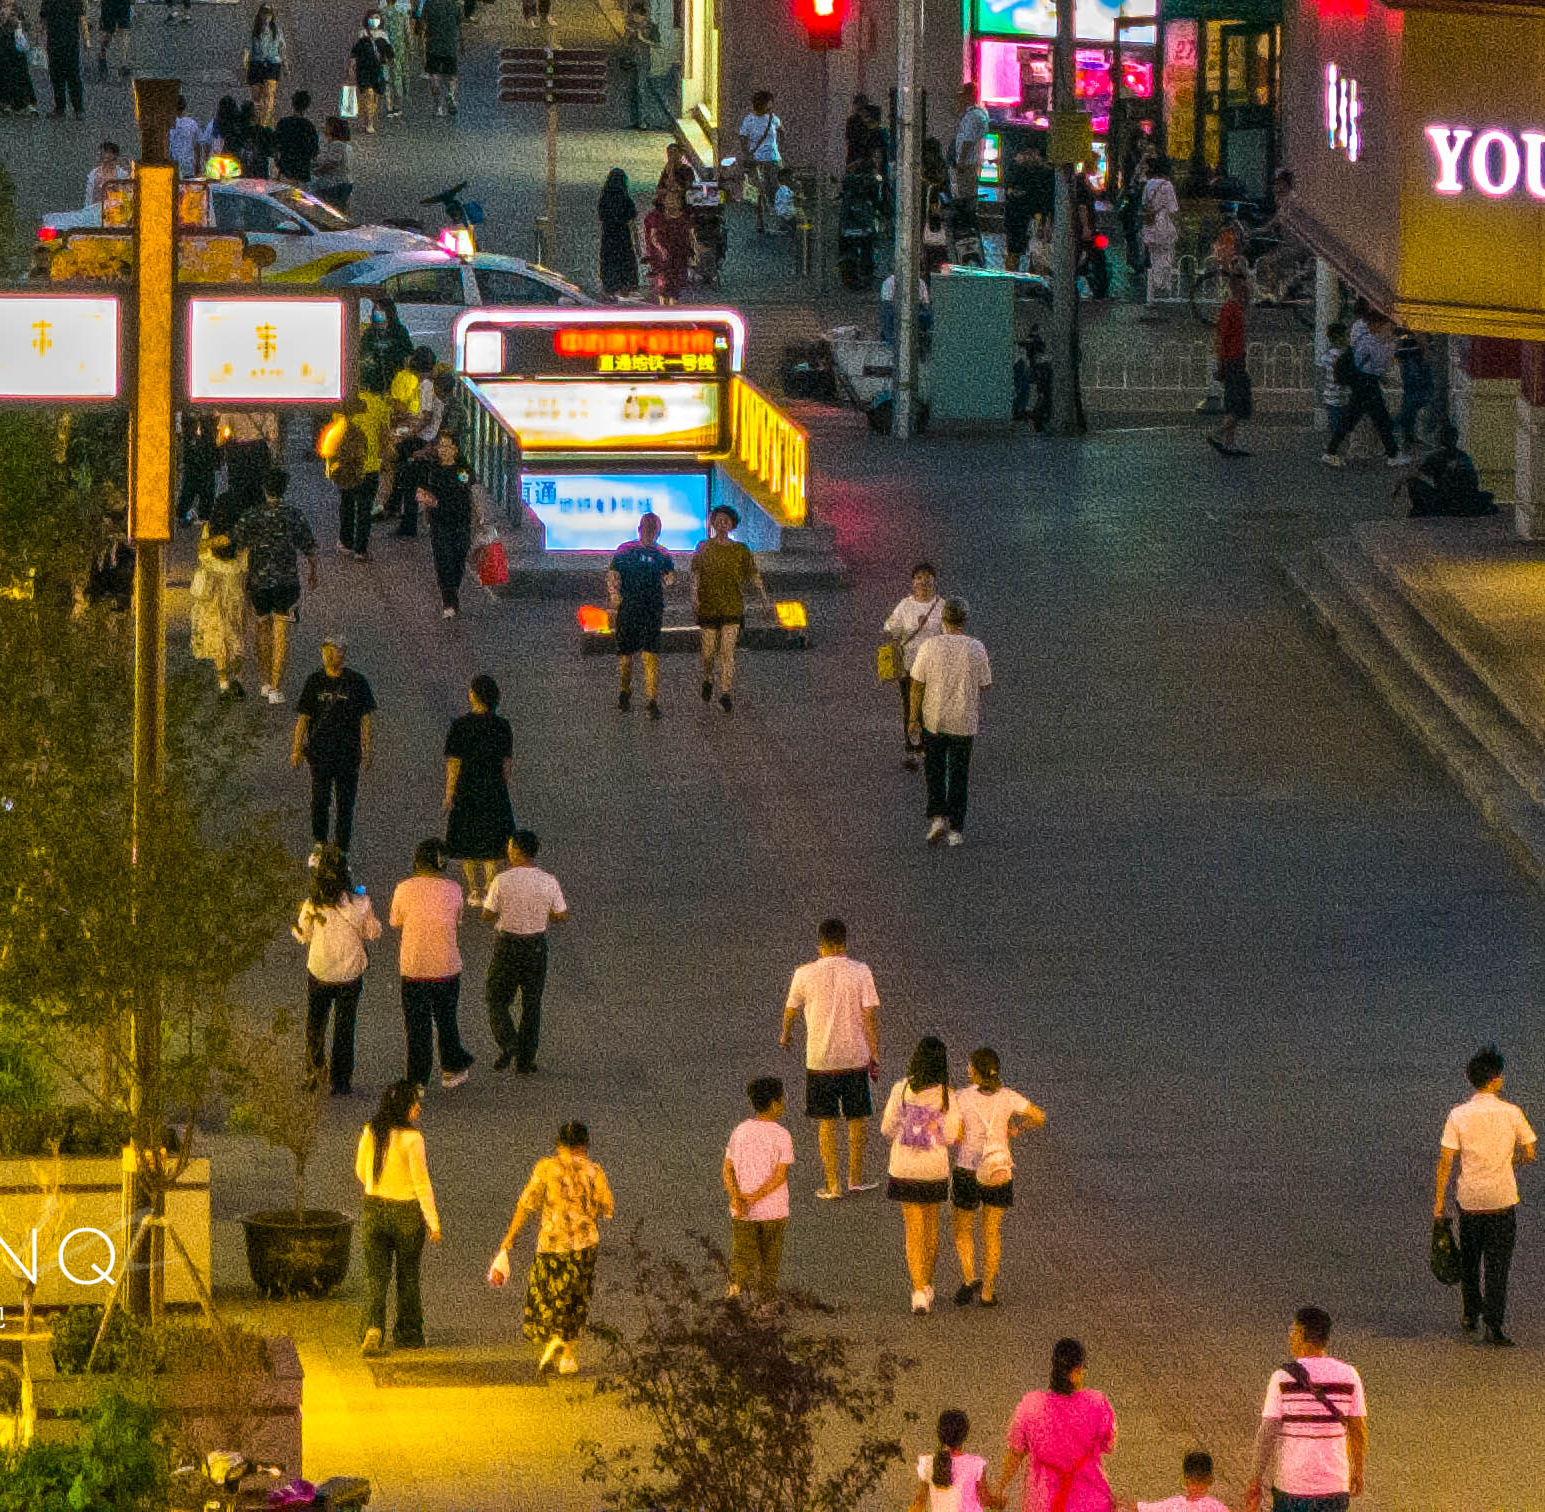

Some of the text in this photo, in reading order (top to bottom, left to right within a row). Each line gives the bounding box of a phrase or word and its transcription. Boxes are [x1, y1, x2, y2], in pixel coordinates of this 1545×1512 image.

[600, 354, 715, 372] 直通地铁一号线
